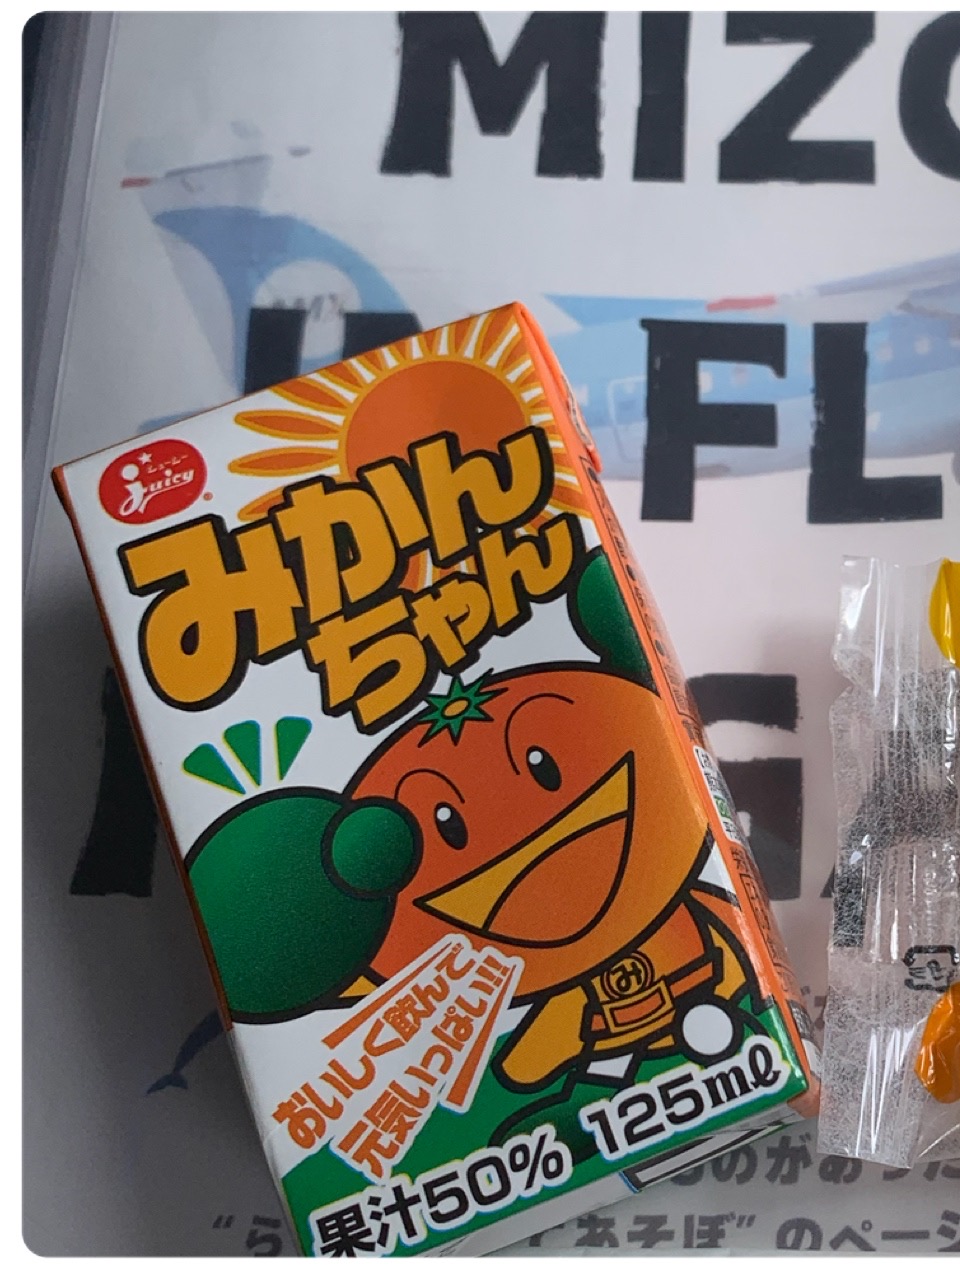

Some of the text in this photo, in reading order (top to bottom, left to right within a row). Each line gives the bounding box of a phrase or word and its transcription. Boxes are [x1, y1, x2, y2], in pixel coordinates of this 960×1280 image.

[119, 463, 195, 517] juicy
[120, 426, 553, 710] みかん
[307, 513, 588, 735] ちゃん
[272, 942, 476, 1150] おいしく飲んで
[337, 954, 511, 1180] 元気いっぱい!!
[610, 959, 646, 995] み
[316, 1131, 565, 1258] 果汁50%
